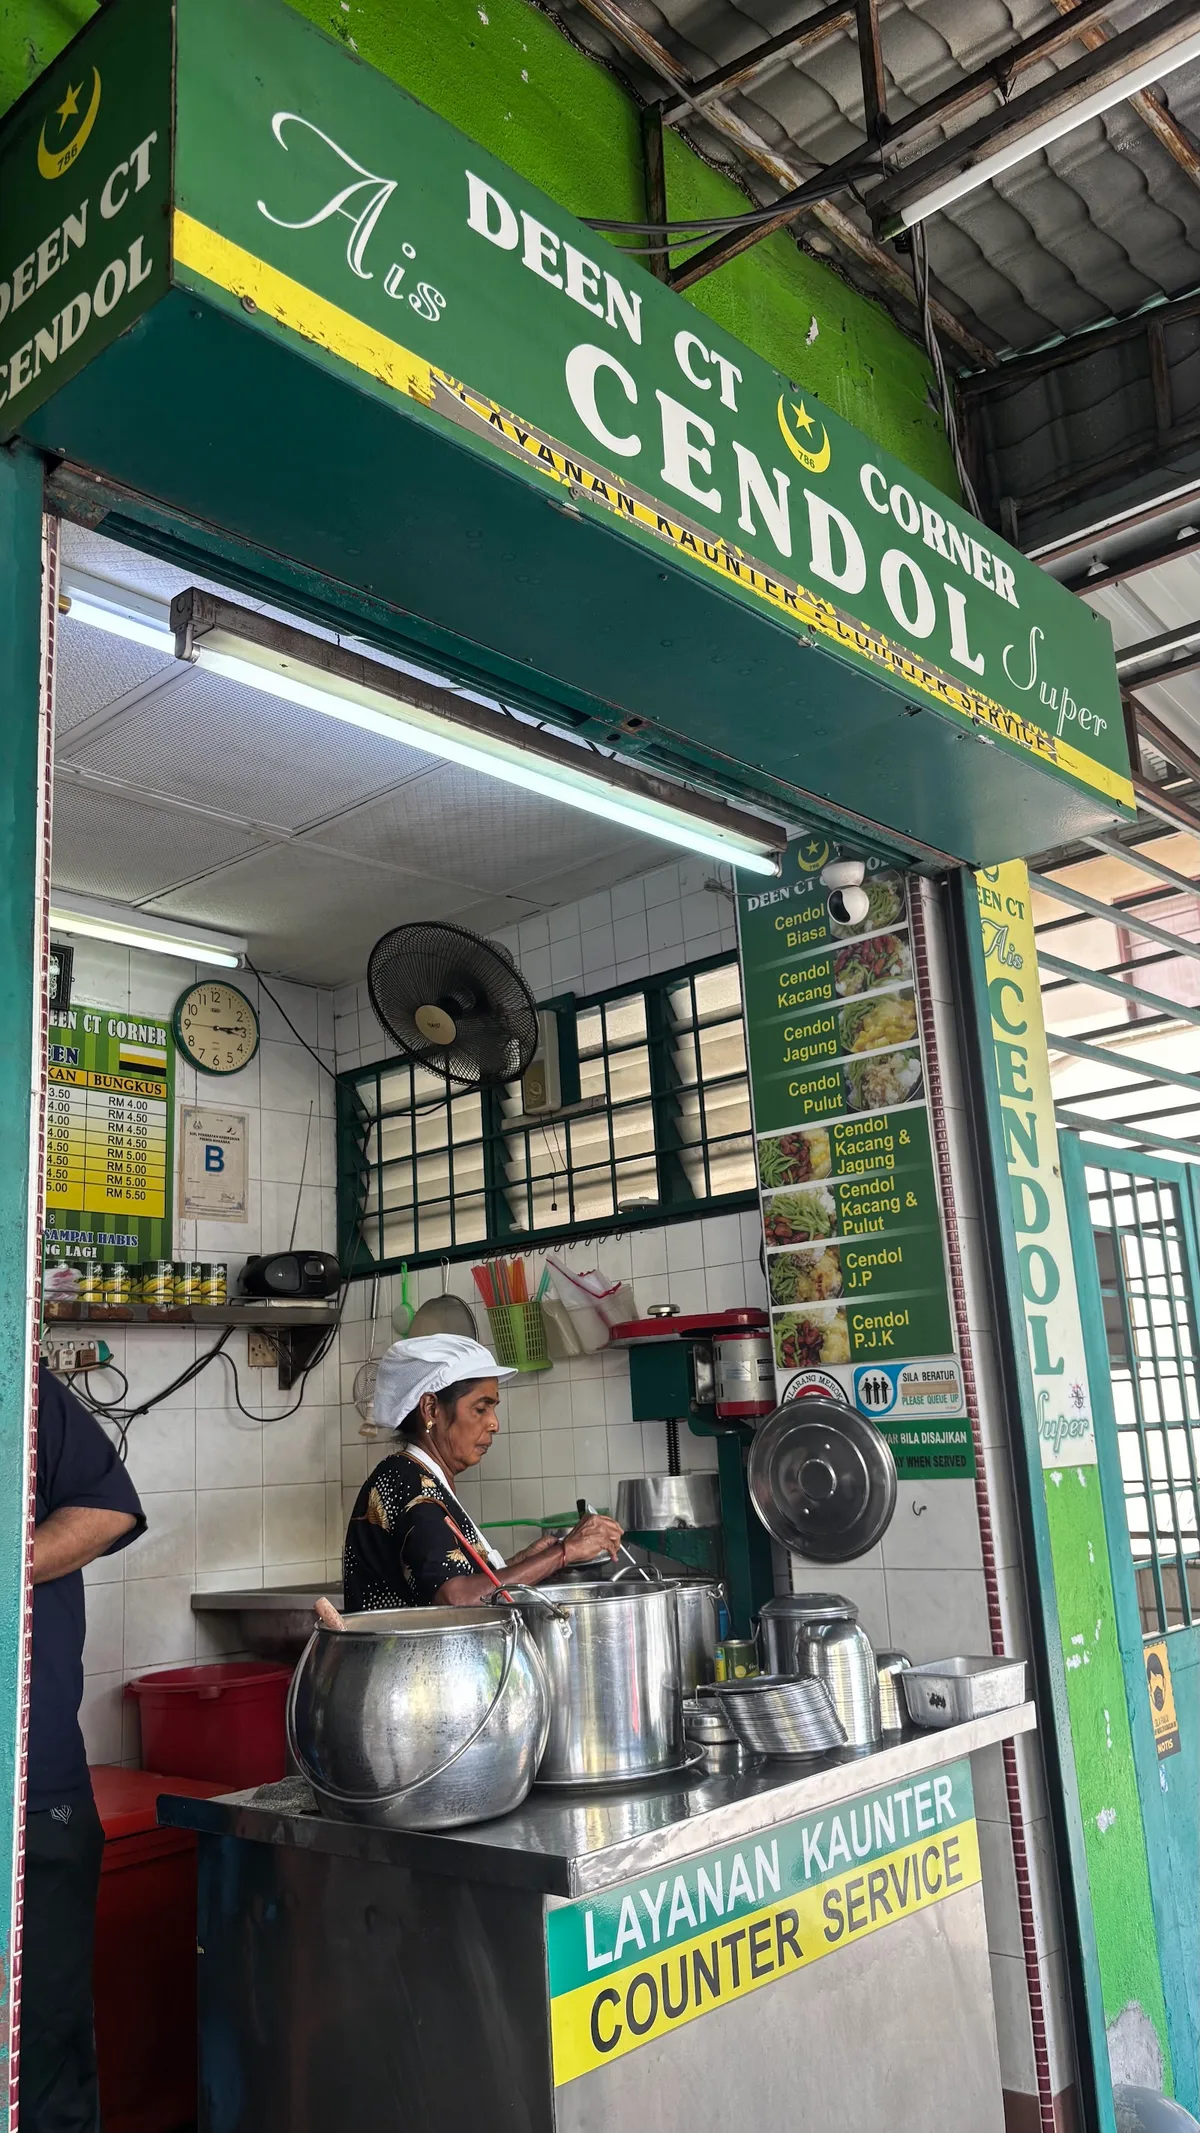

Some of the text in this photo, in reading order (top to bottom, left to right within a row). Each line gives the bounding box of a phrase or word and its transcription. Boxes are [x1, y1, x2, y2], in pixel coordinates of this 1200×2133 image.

[57, 143, 79, 172] 786
[100, 130, 157, 220] CT
[257, 112, 446, 322] Ais
[465, 169, 1020, 609] DEEN CT CORNER
[798, 450, 816, 470] 786
[565, 343, 985, 676] CENDOL
[459, 392, 635, 517] AYANAN
[961, 692, 1048, 751] SERVICE
[1002, 626, 1108, 737] Super
[747, 877, 816, 912] DEEN CT
[774, 903, 826, 932] Cendol
[1005, 897, 1025, 920] CT
[786, 925, 827, 948] Biasa
[980, 917, 1024, 970] Ais
[779, 961, 831, 988] Cendol
[199, 994, 206, 1005] 11
[211, 991, 220, 1003] 12
[777, 982, 833, 1009] Kacang
[188, 1004, 198, 1016] 10
[236, 1011, 243, 1022] 2
[83, 1014, 102, 1034] CT
[107, 1018, 167, 1046] CORNER
[184, 1018, 192, 1030] 9
[240, 1027, 247, 1038] 3
[784, 1016, 836, 1043] Cendol
[188, 1035, 195, 1046] 8
[236, 1043, 244, 1054] 4
[783, 1038, 838, 1063] Jagung
[199, 1048, 206, 1059] 7
[213, 1055, 220, 1066] 6
[227, 1052, 234, 1063] 5
[48, 1087, 71, 1099] 3.50
[93, 1074, 162, 1096] BUNGKUS
[788, 1072, 841, 1098] Cendol
[48, 1101, 70, 1112] 4.00
[108, 1096, 148, 1111] RM 4.00
[804, 1093, 844, 1115] Pulut
[47, 1114, 70, 1126] 4.00
[108, 1109, 148, 1123] RM 4.50
[47, 1128, 69, 1139] 4.00
[107, 1122, 148, 1136] RM 4.50
[833, 1115, 889, 1140] Cendol
[47, 1141, 69, 1153] 4.50
[107, 1135, 147, 1149] RM 4.50
[835, 1129, 911, 1158] Kacang &
[46, 1155, 69, 1166] 4.50
[107, 1148, 147, 1162] RM 5.00
[205, 1144, 225, 1172] B
[837, 1152, 896, 1176] Jagung
[46, 1168, 68, 1179] 4.50
[107, 1161, 147, 1175] RM 5.00
[989, 977, 1064, 1376] CENDOL
[46, 1181, 68, 1193] 5.00
[106, 1174, 147, 1188] RM 5.00
[839, 1176, 895, 1199] Cendol
[106, 1187, 146, 1201] RM 5.50
[841, 1191, 918, 1218] Kacang &
[843, 1215, 885, 1236] Pulut
[45, 1227, 139, 1248] SAMPAI HABIS
[846, 1247, 903, 1269] Cendol
[848, 1270, 873, 1288] J.P
[852, 1310, 909, 1331] Cendol
[854, 1329, 895, 1349] P.J.K
[902, 1370, 955, 1383] SILA BERATUR
[901, 1393, 959, 1405] PLEASE QUEUE UP
[900, 1432, 920, 1444] BILA
[921, 1431, 968, 1444] DISAJIKAN
[906, 1455, 932, 1468] WHEN
[933, 1454, 967, 1468] SERVED
[1157, 1738, 1174, 1754] NOTIS
[586, 1773, 957, 1972] LAYANAN KAUNTER
[590, 1835, 965, 2054] COUNTER SERVICE
